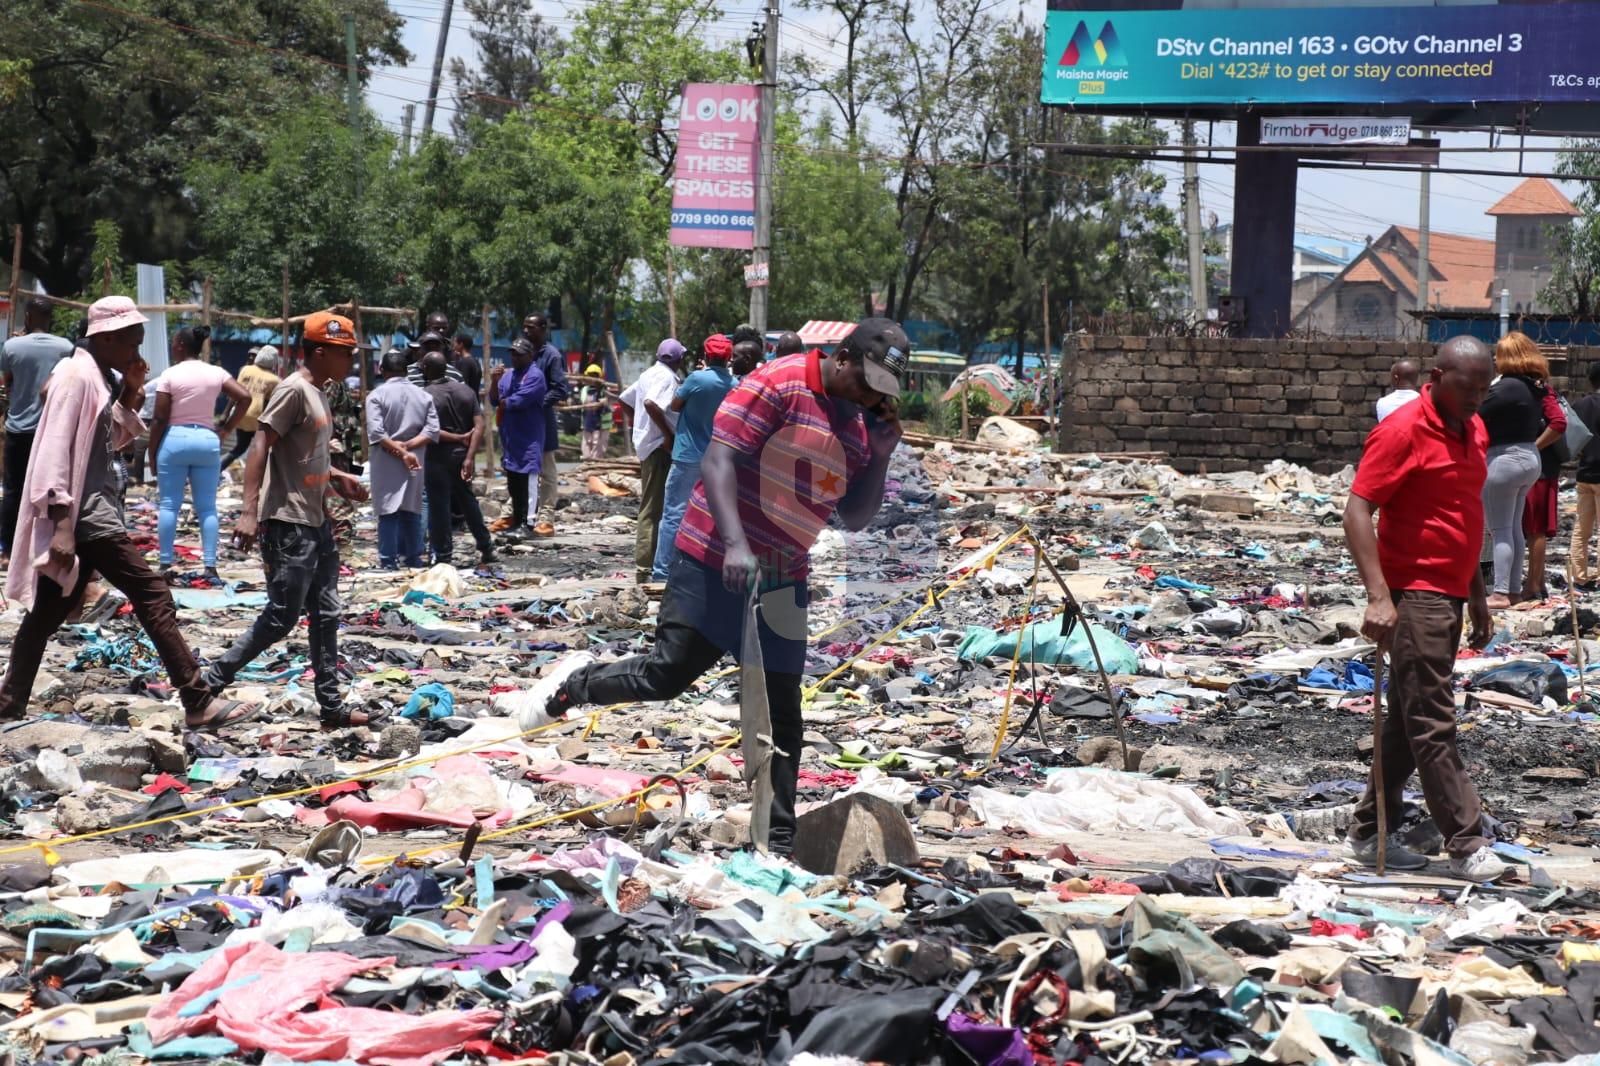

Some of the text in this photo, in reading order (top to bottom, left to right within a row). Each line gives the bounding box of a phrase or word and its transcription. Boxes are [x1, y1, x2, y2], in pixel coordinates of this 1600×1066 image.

[1157, 33, 1522, 56] DStv Channel 163 GOtv Channel 3
[1056, 69, 1129, 81] Maisha Magic
[1181, 63, 1214, 79] Dial
[1275, 64, 1292, 78] to
[1297, 63, 1326, 82] get
[1331, 64, 1350, 78] or
[1354, 63, 1391, 82] stay
[1396, 60, 1493, 78] connected
[1549, 74, 1584, 87] T&Cs
[1081, 82, 1103, 92] Plus
[681, 97, 758, 123] LOOK
[698, 131, 739, 151] GET
[1361, 125, 1378, 137] 0718
[684, 155, 749, 175] THESE
[675, 179, 755, 199] SPACES
[671, 213, 755, 226] 0799 900 666
